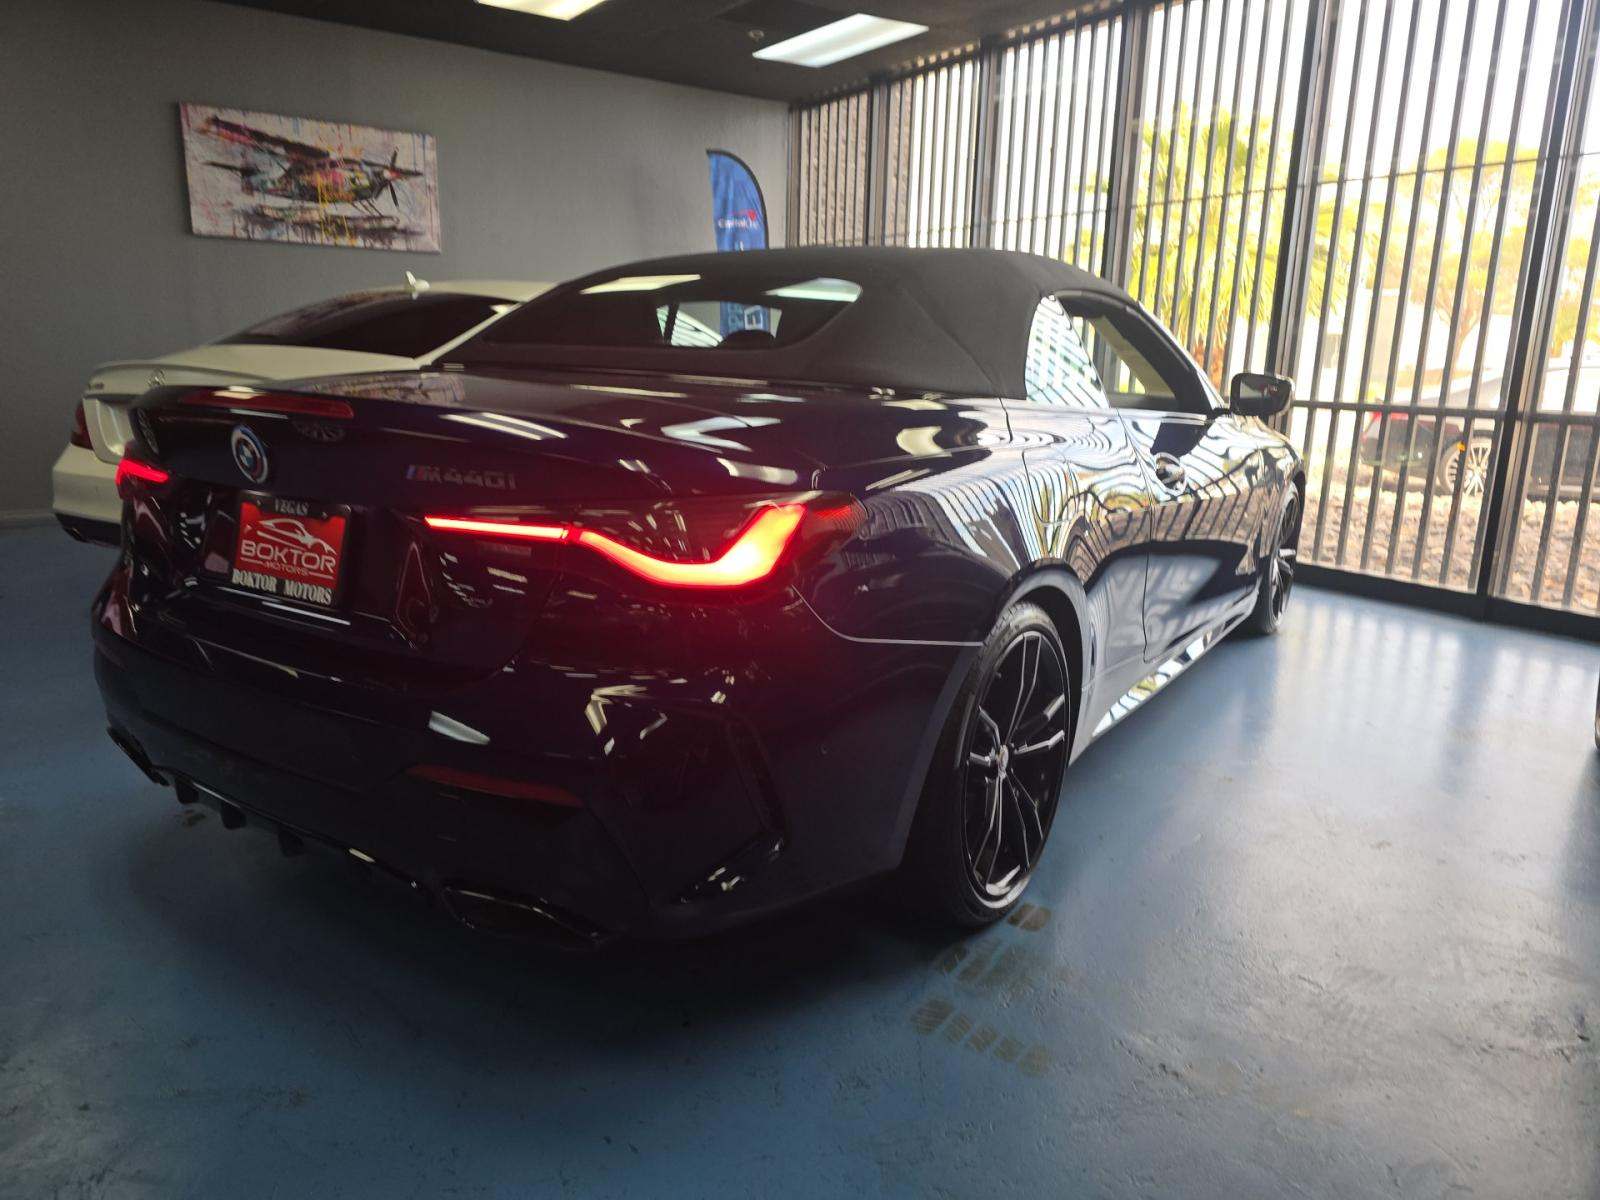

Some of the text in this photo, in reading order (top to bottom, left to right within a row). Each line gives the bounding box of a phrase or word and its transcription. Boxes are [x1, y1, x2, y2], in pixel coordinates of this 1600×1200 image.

[274, 499, 309, 515] VEGAS
[240, 540, 336, 573] BOKTOR
[264, 561, 309, 576] MOTORS
[231, 568, 332, 604] BOKTOR MOTORS
